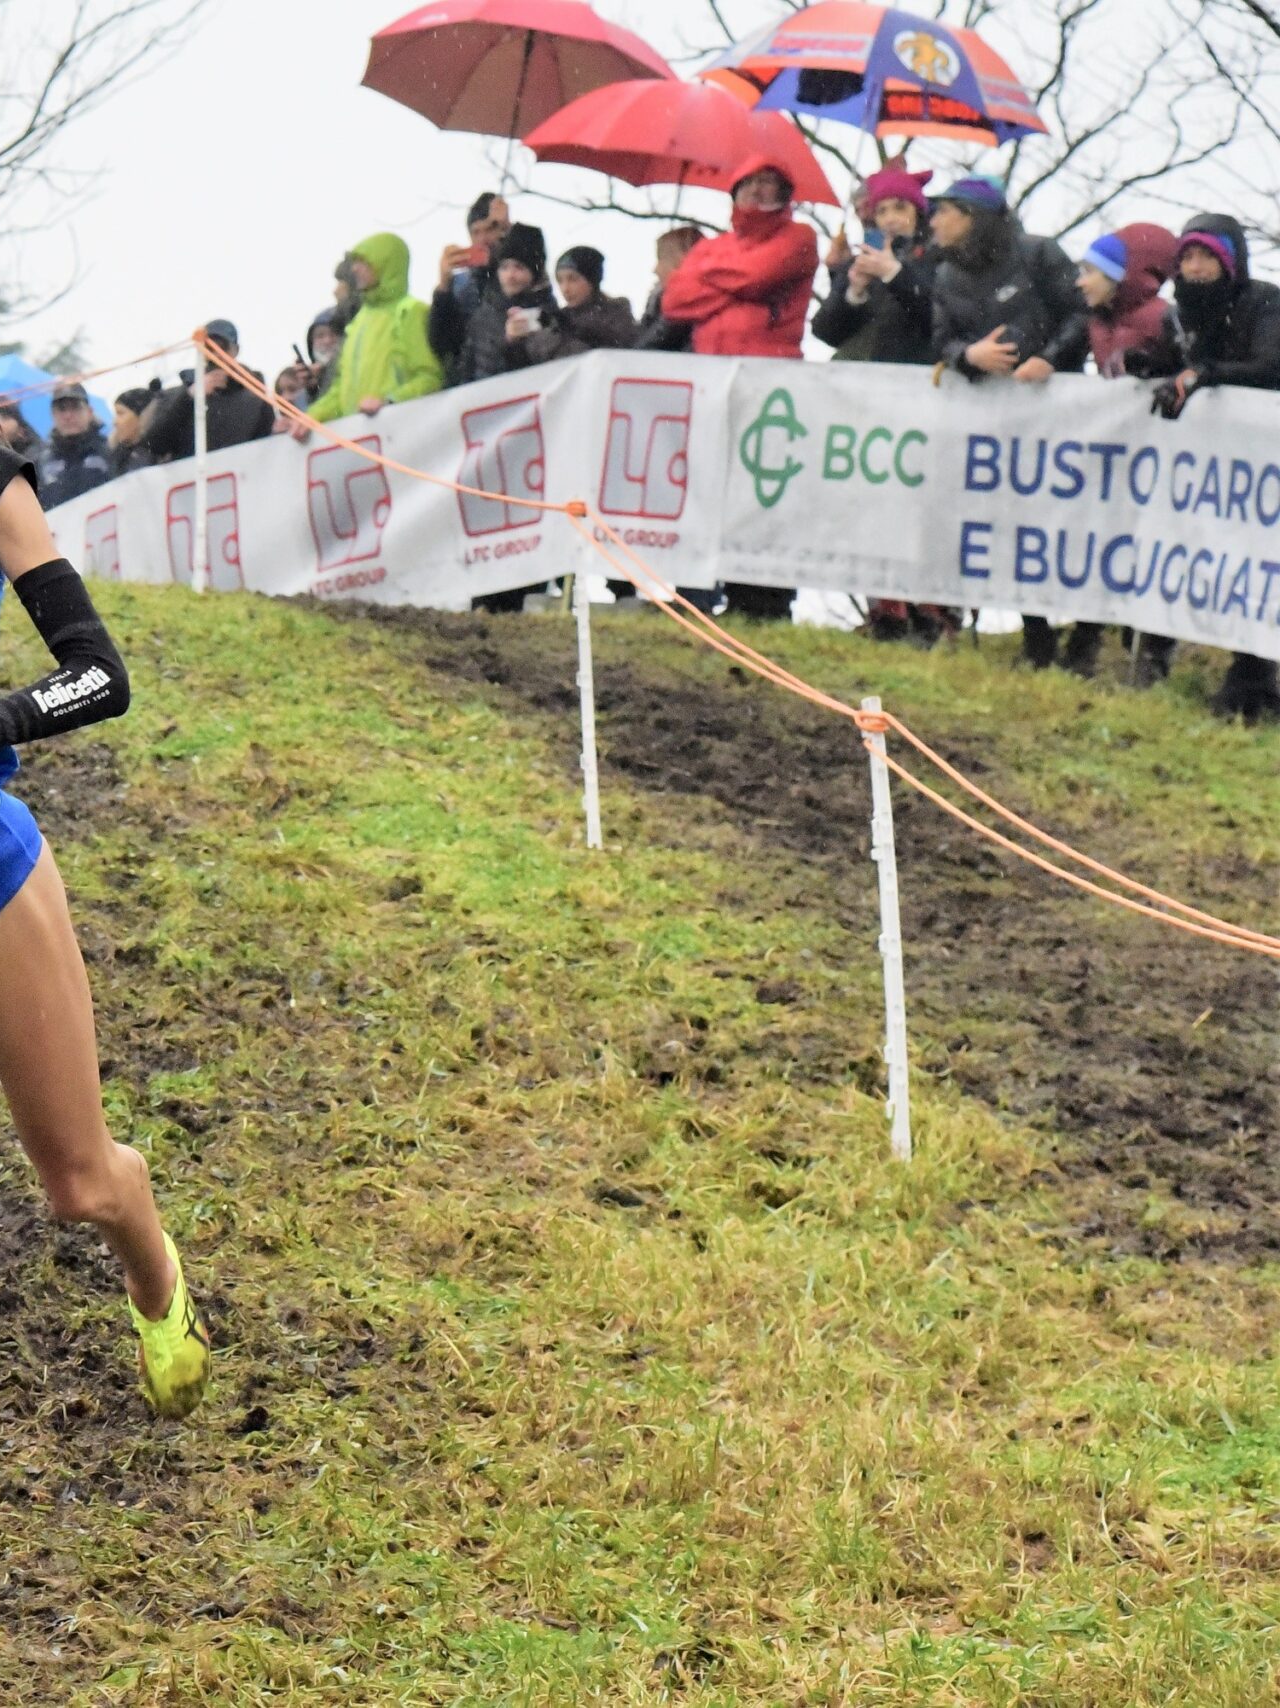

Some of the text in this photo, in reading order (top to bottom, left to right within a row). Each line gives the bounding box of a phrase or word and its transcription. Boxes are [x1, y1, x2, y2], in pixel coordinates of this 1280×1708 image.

[823, 423, 928, 488] BCC
[964, 433, 1280, 527] BUSTO GARO
[464, 534, 542, 567] LTC GROUP
[623, 529, 680, 549] GROUP
[335, 567, 387, 592] GROUP
[960, 521, 993, 579] E
[1014, 526, 1280, 627] BUGUGGIAT
[52, 699, 91, 718] DOLOMITI
